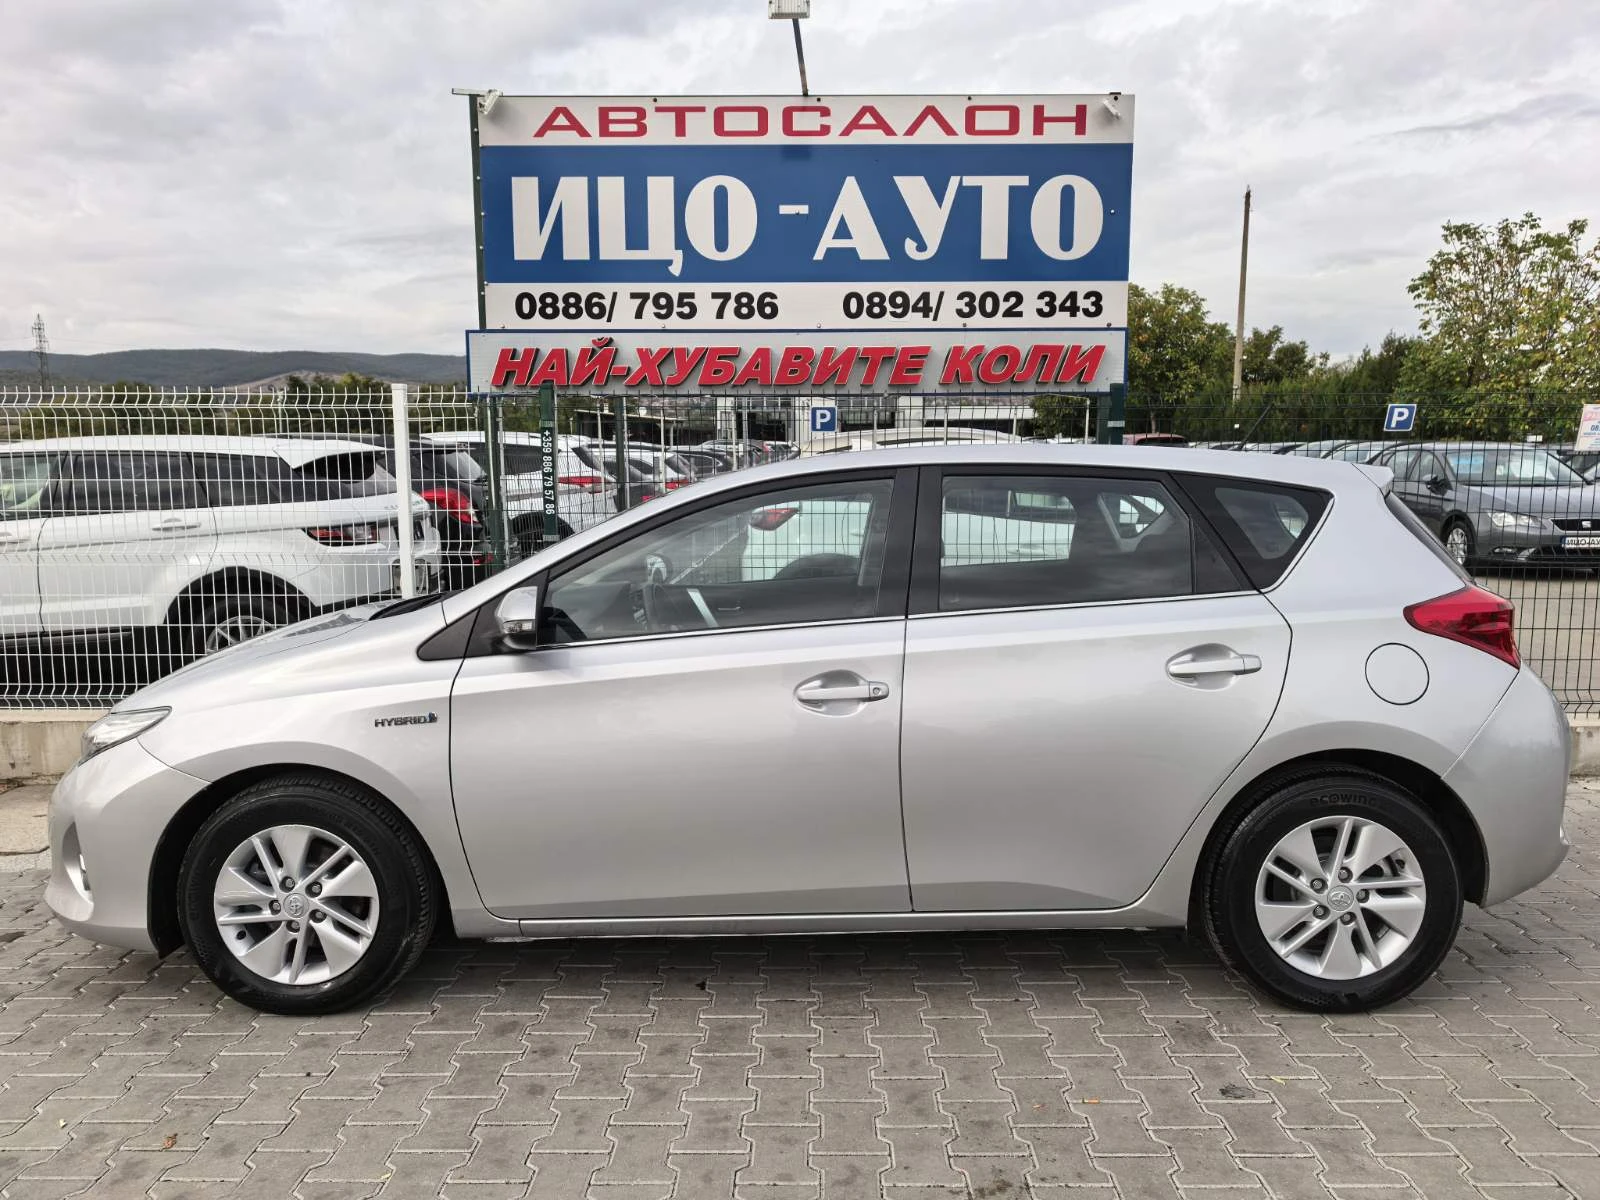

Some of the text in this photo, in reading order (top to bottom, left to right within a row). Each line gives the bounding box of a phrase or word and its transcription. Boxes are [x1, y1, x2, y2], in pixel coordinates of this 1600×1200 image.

[535, 105, 1087, 138] АВТОСАЛОН
[515, 291, 779, 322] 0886/ 795 786
[842, 290, 1103, 321] 0894/ 302 343
[490, 337, 1107, 386] НАЙ-ХУБАВИТЕ КОЛИ
[816, 409, 831, 430] P
[1390, 407, 1410, 428] P
[542, 429, 556, 515] +359 886 79 57 86
[374, 715, 428, 728] HYBRID
